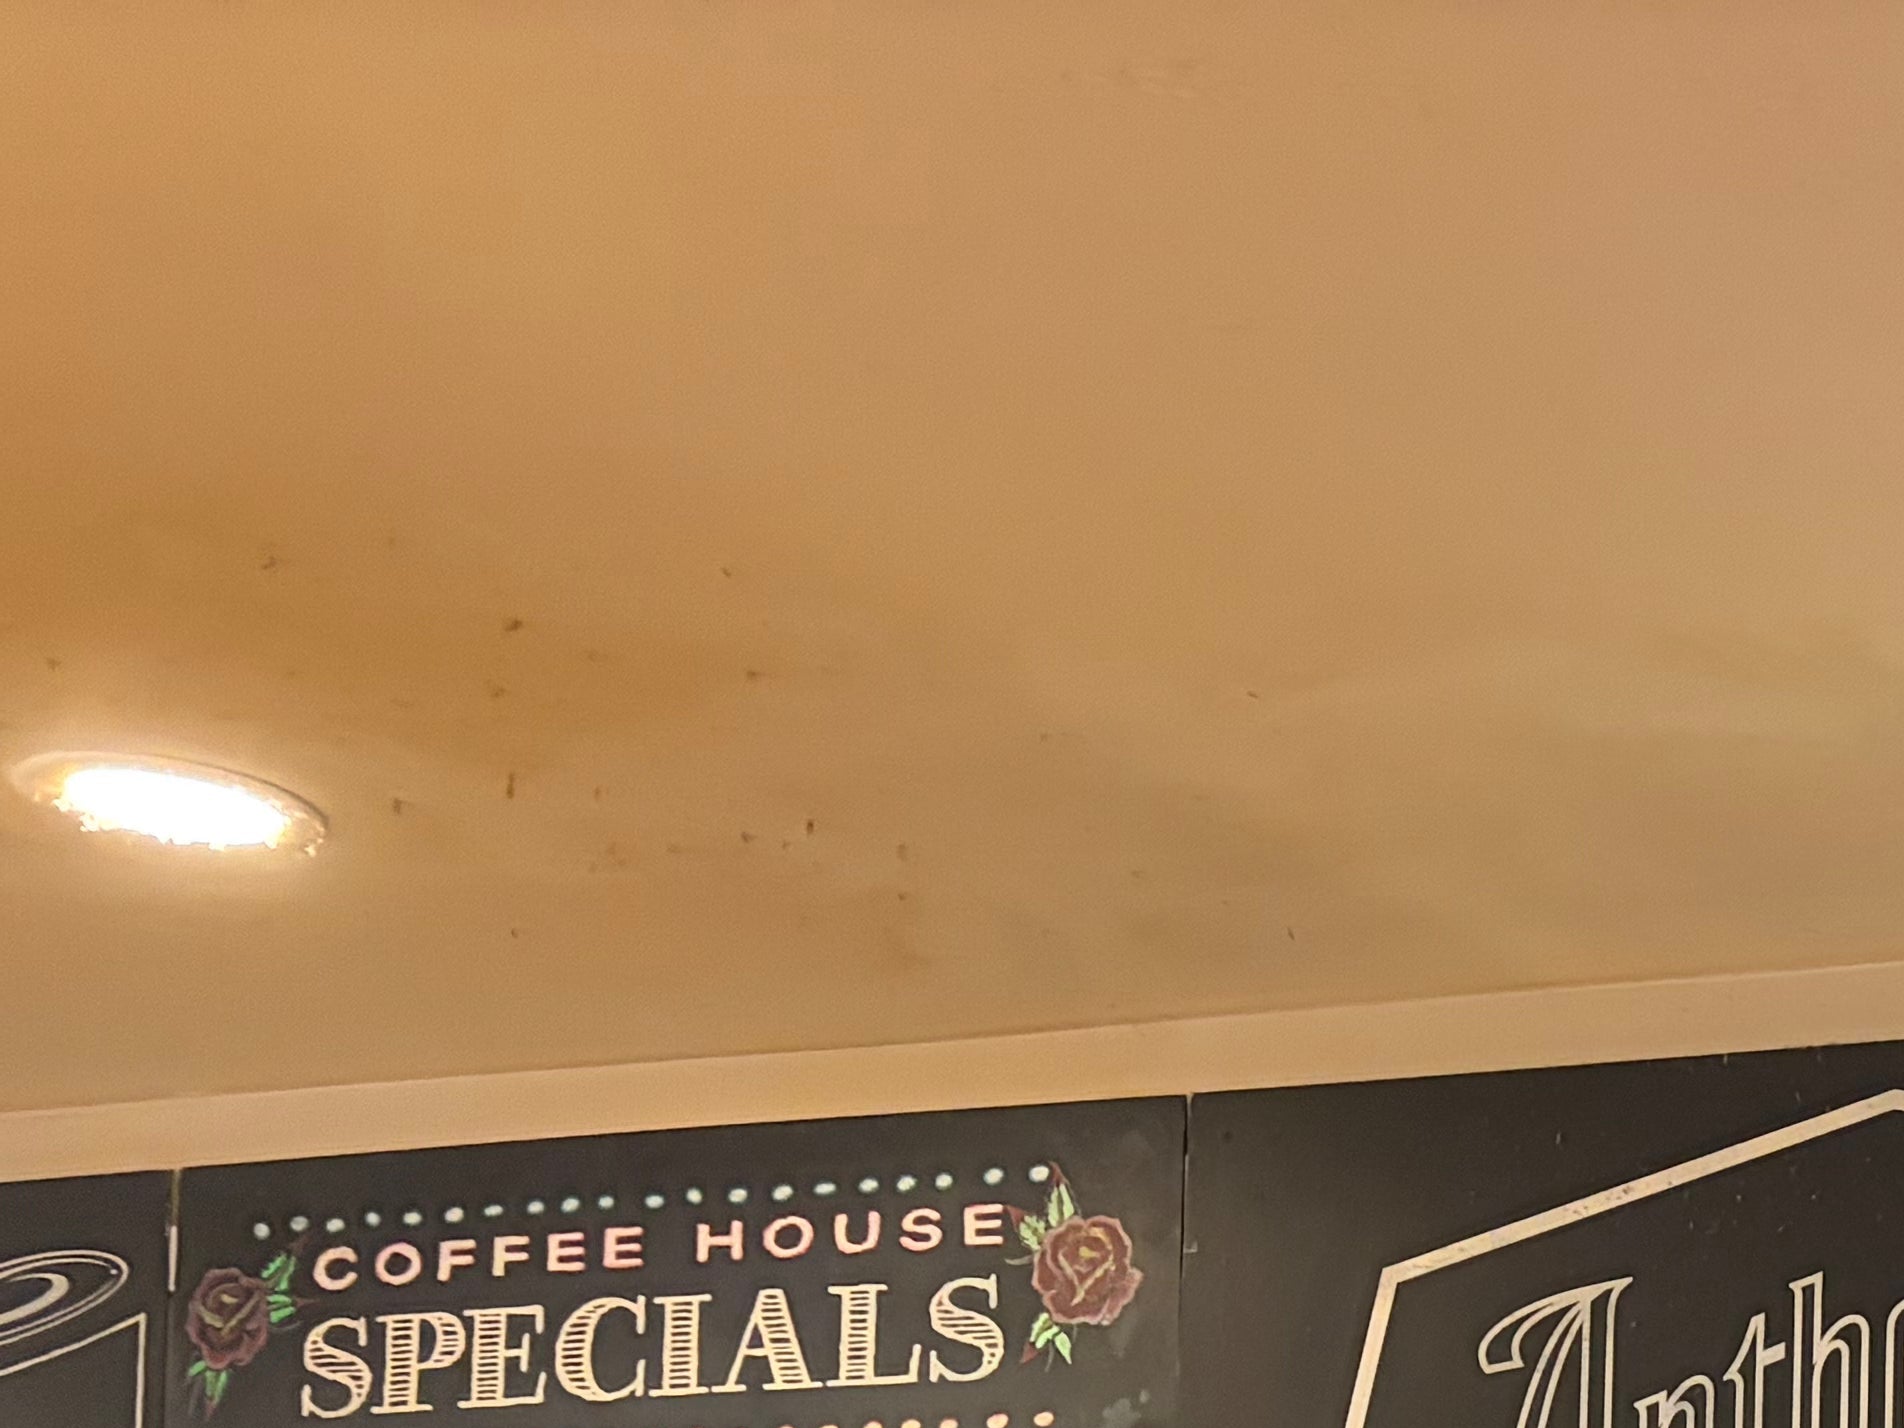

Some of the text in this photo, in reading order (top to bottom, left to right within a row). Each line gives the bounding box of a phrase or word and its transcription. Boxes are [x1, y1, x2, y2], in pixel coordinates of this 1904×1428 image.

[314, 1199, 1005, 1290] COFFEE HOUSE
[302, 1260, 1004, 1418] SPECIALS
